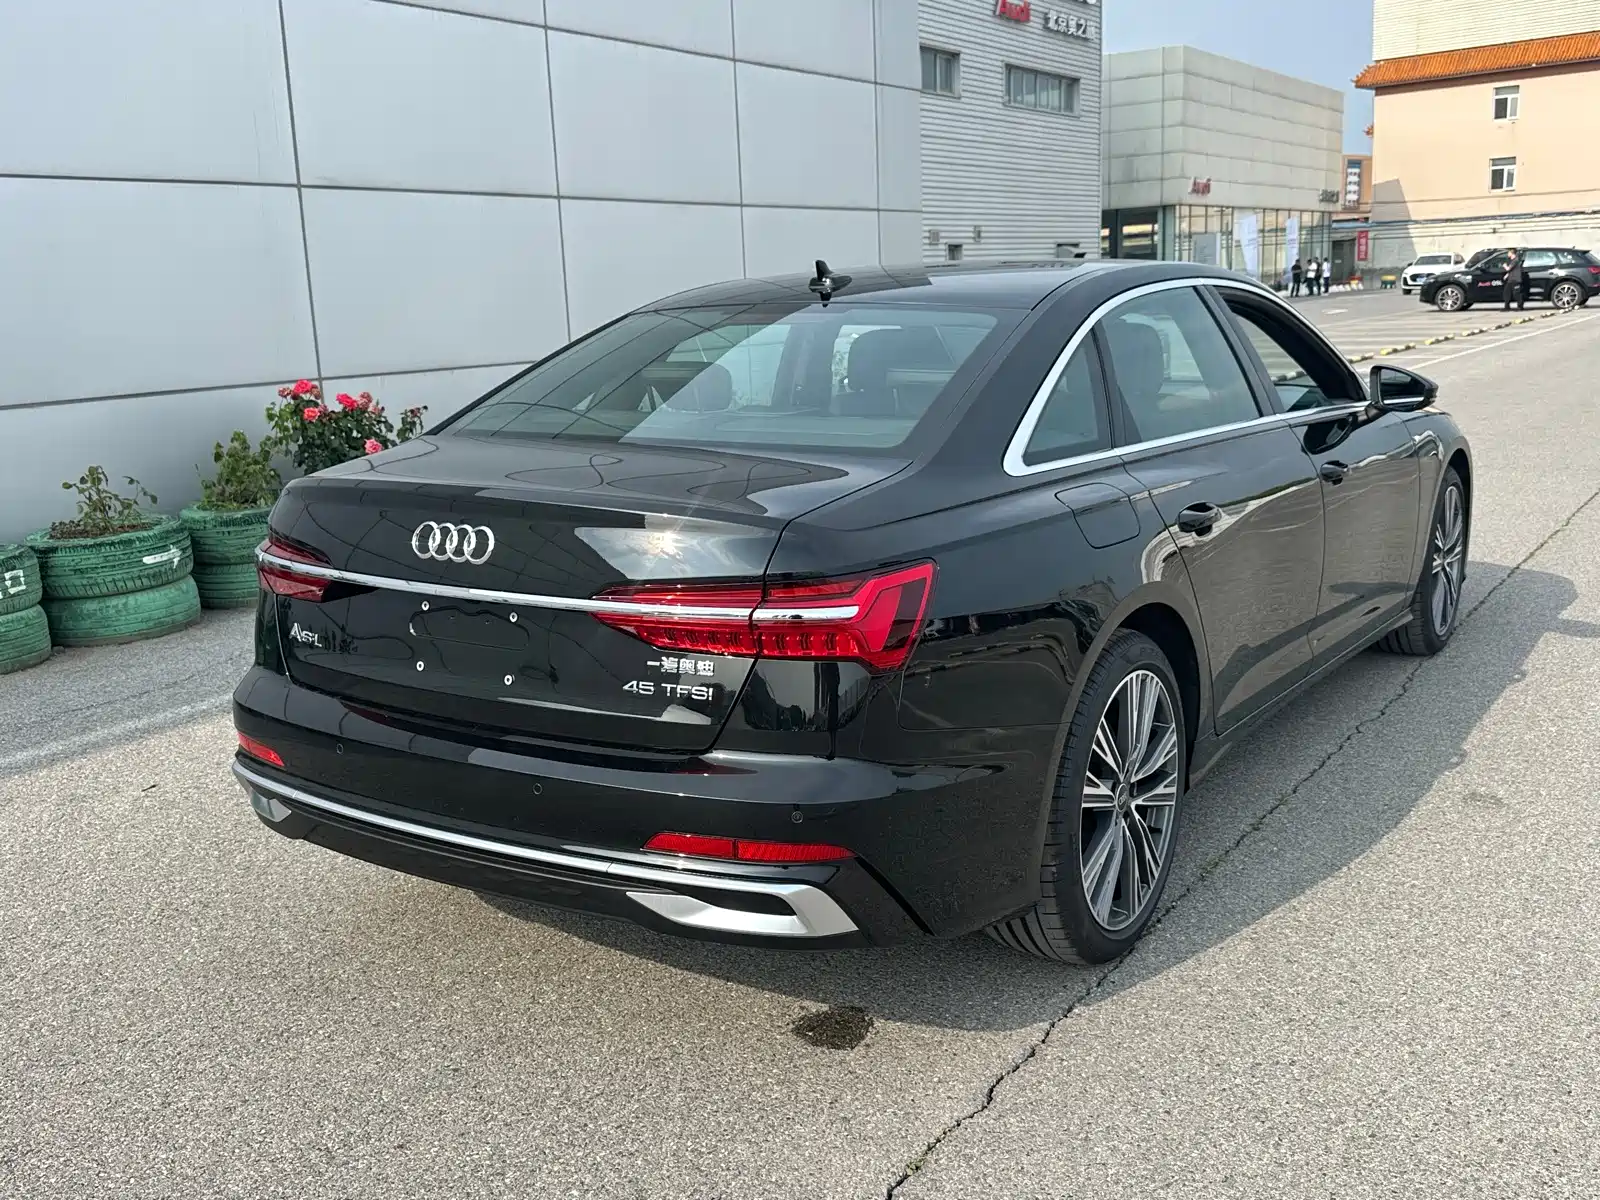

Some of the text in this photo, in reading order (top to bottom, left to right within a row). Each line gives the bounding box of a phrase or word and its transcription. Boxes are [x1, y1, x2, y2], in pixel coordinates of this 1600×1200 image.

[994, 0, 1030, 22] Audi
[289, 622, 322, 647] A6L
[646, 656, 714, 676] 一汽奥迪
[622, 681, 713, 700] 45 TFSI
